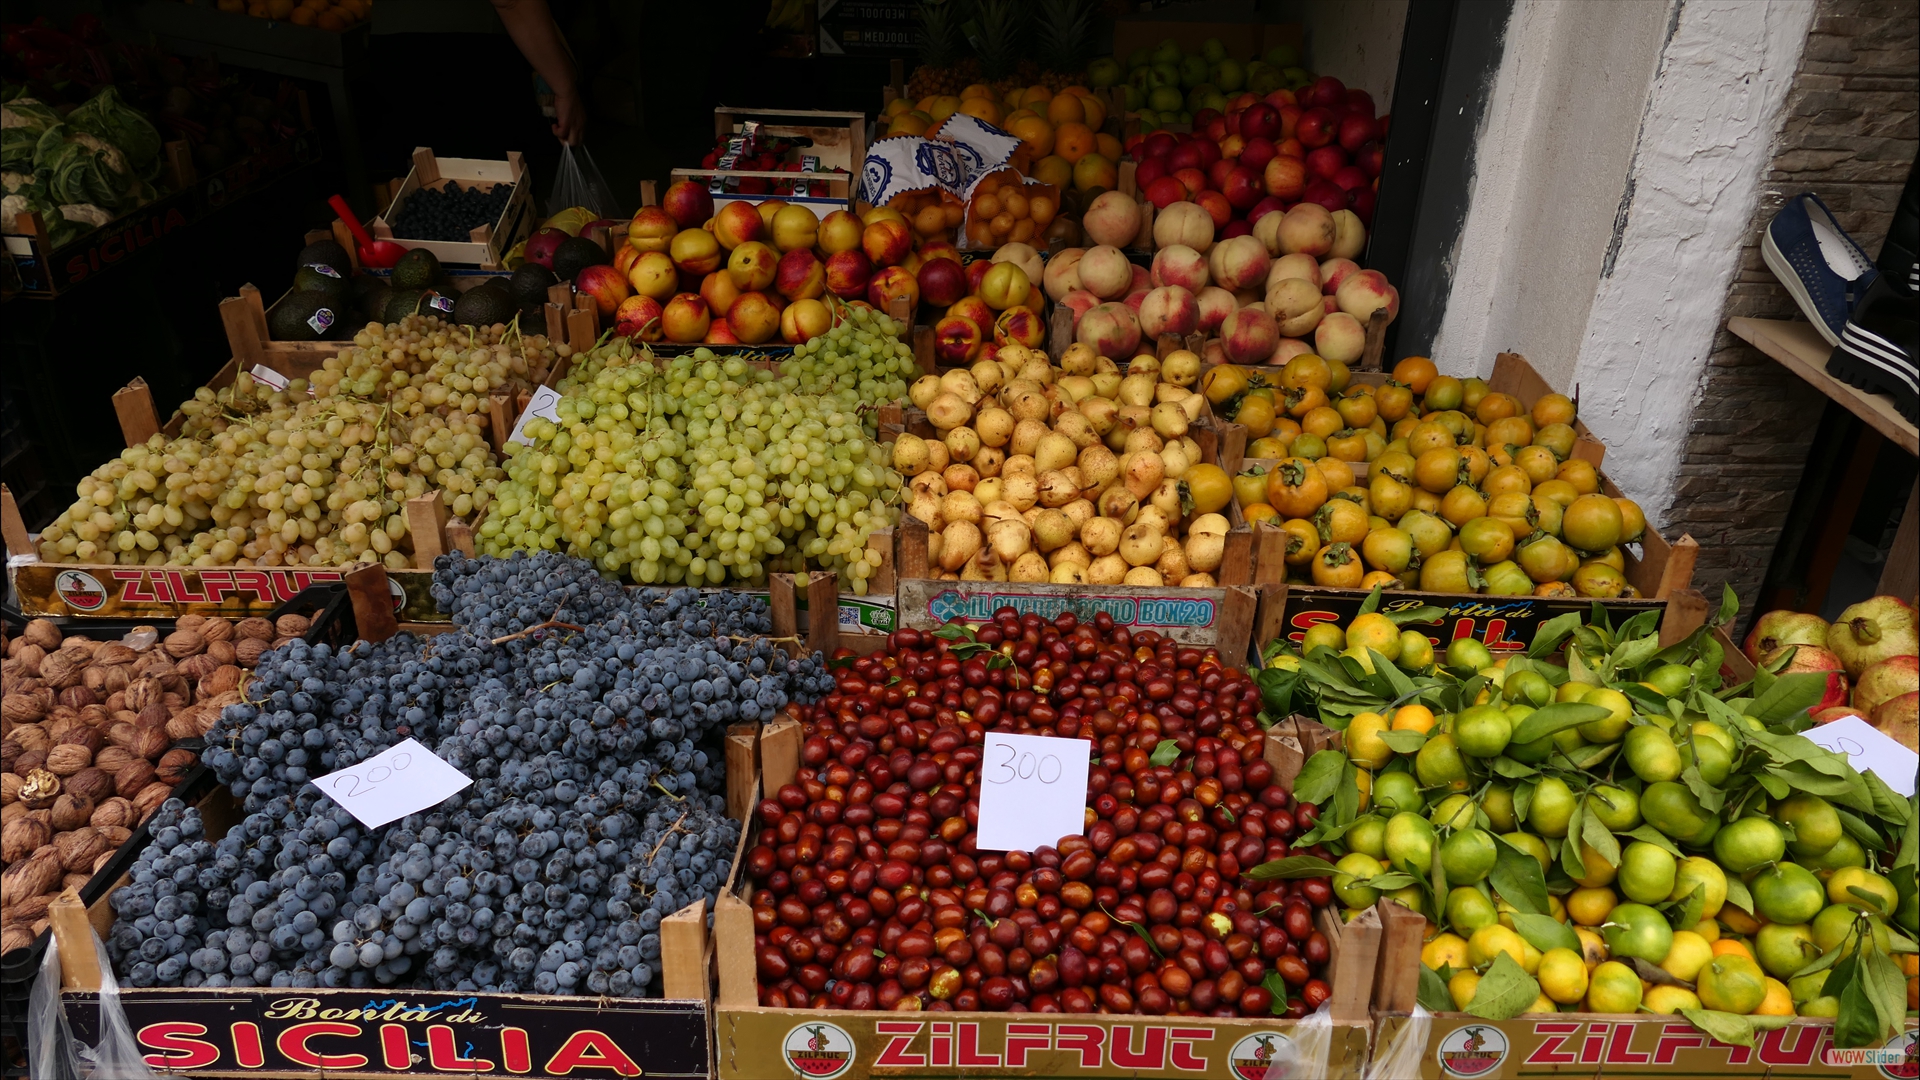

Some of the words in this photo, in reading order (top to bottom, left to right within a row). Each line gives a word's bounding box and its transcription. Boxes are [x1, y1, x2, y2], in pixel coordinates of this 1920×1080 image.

[861, 7, 906, 20] MEDJOOL
[864, 31, 910, 44] MEDJOOL
[66, 207, 186, 284] SICILIA
[1505, 606, 1536, 619] di
[334, 753, 412, 797] 200
[988, 743, 1062, 784] 300
[264, 996, 442, 1023] Bontà
[447, 1005, 489, 1025] di
[137, 1020, 645, 1078] SICILIA
